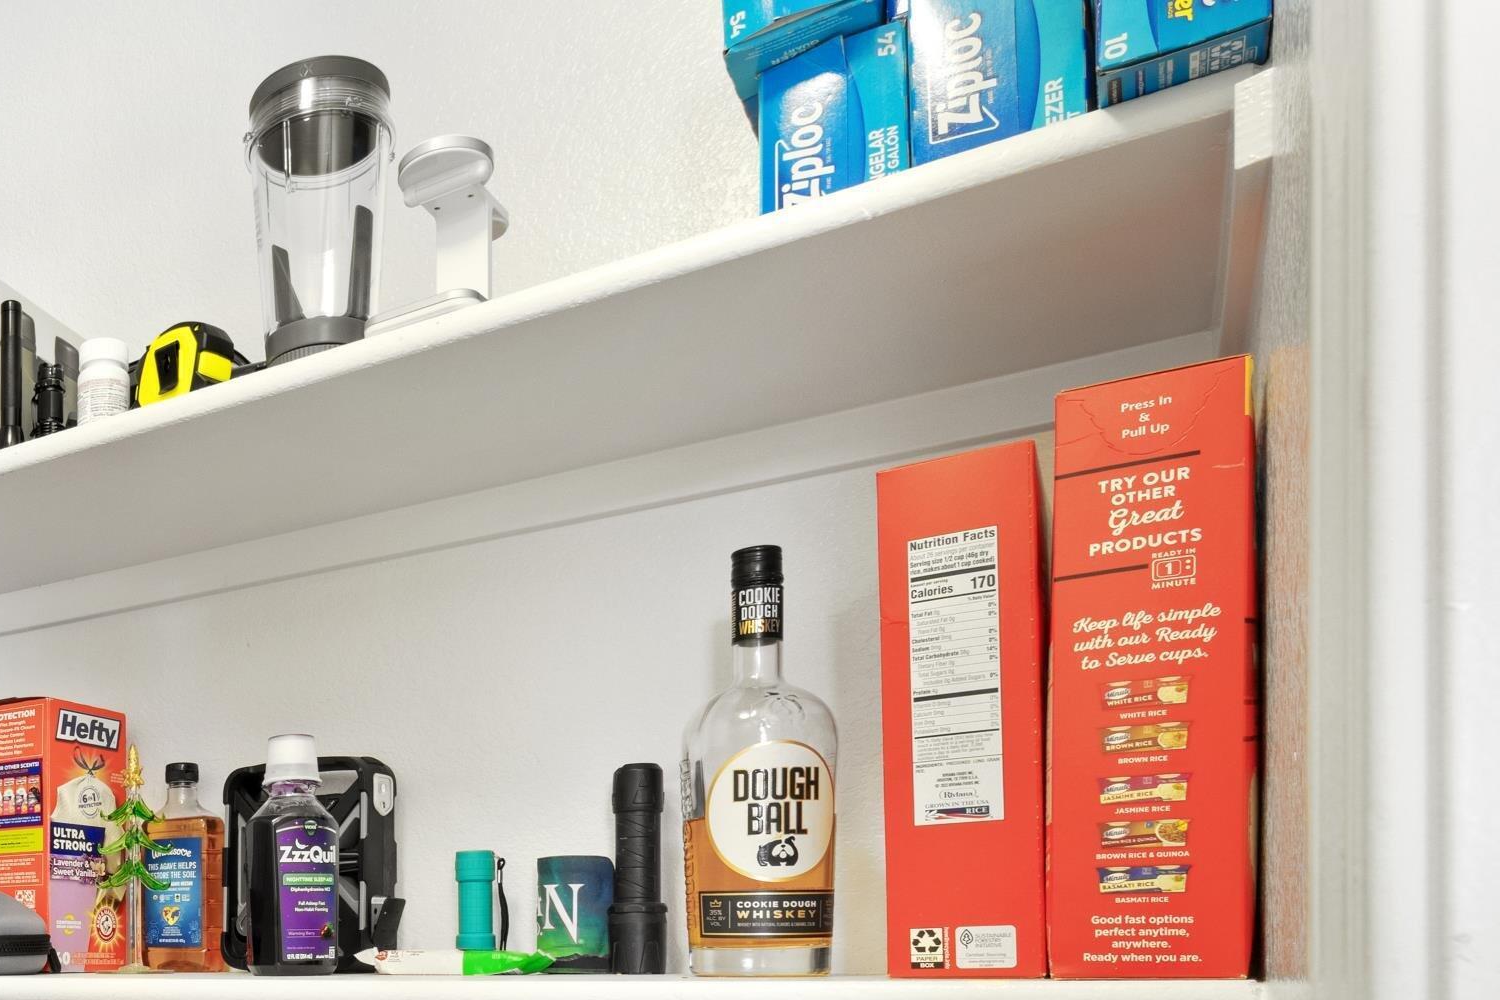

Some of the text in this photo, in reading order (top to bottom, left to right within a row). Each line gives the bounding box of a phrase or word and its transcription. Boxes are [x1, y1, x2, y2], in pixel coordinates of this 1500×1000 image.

[877, 30, 897, 58] 54
[1104, 31, 1128, 60] 10
[935, 12, 997, 135] Ziploc
[1120, 396, 1173, 413] Press In
[1138, 412, 1151, 423] &
[1121, 423, 1170, 439] Pull Up
[1097, 466, 1191, 494] TRY OUR
[1111, 485, 1176, 506] OTHER
[1108, 499, 1184, 536] Great
[909, 536, 959, 552] Nutrition
[963, 529, 996, 542] Facts
[1089, 527, 1203, 557] PRODUCTS
[1151, 547, 1196, 559] READY IN
[910, 573, 996, 599] Calories 170
[1151, 577, 1197, 590] MINUTE
[738, 587, 781, 607] COOKIE
[740, 604, 778, 621] DOUGH
[1072, 602, 1221, 634] Keep life simple
[738, 618, 781, 635] WHISKEY
[1073, 623, 1217, 652] with our Ready
[1081, 646, 1209, 670] to Serve cups.
[1119, 709, 1168, 720] WHITE RICE
[60, 712, 117, 748] Hefty
[4, 763, 20, 771] OTHER
[1118, 754, 1168, 765] BROWN RICE
[732, 766, 819, 802] DOUGH
[965, 806, 989, 814] RICE
[1115, 805, 1171, 815] JASMINE RICE
[747, 801, 808, 836] BALL
[53, 826, 86, 840] ULTRA
[52, 838, 93, 853] STRONG
[279, 845, 336, 863] ZzzQuil
[1095, 852, 1127, 860] BROWN
[1148, 851, 1155, 859] &
[1156, 850, 1190, 859] QUINOA
[53, 867, 96, 878] Sweet Vanilla
[159, 862, 177, 870] AGAVE
[177, 861, 197, 869] HELPS
[736, 900, 817, 908] COOKIE DOUGH
[1115, 896, 1150, 904] BASMATI
[736, 909, 816, 919] WHISKEY
[1091, 914, 1194, 926] Good fast options
[1094, 926, 1190, 938] perfect anytime,
[1111, 939, 1172, 950] anywhere.
[1083, 952, 1203, 964] Ready when you are.
